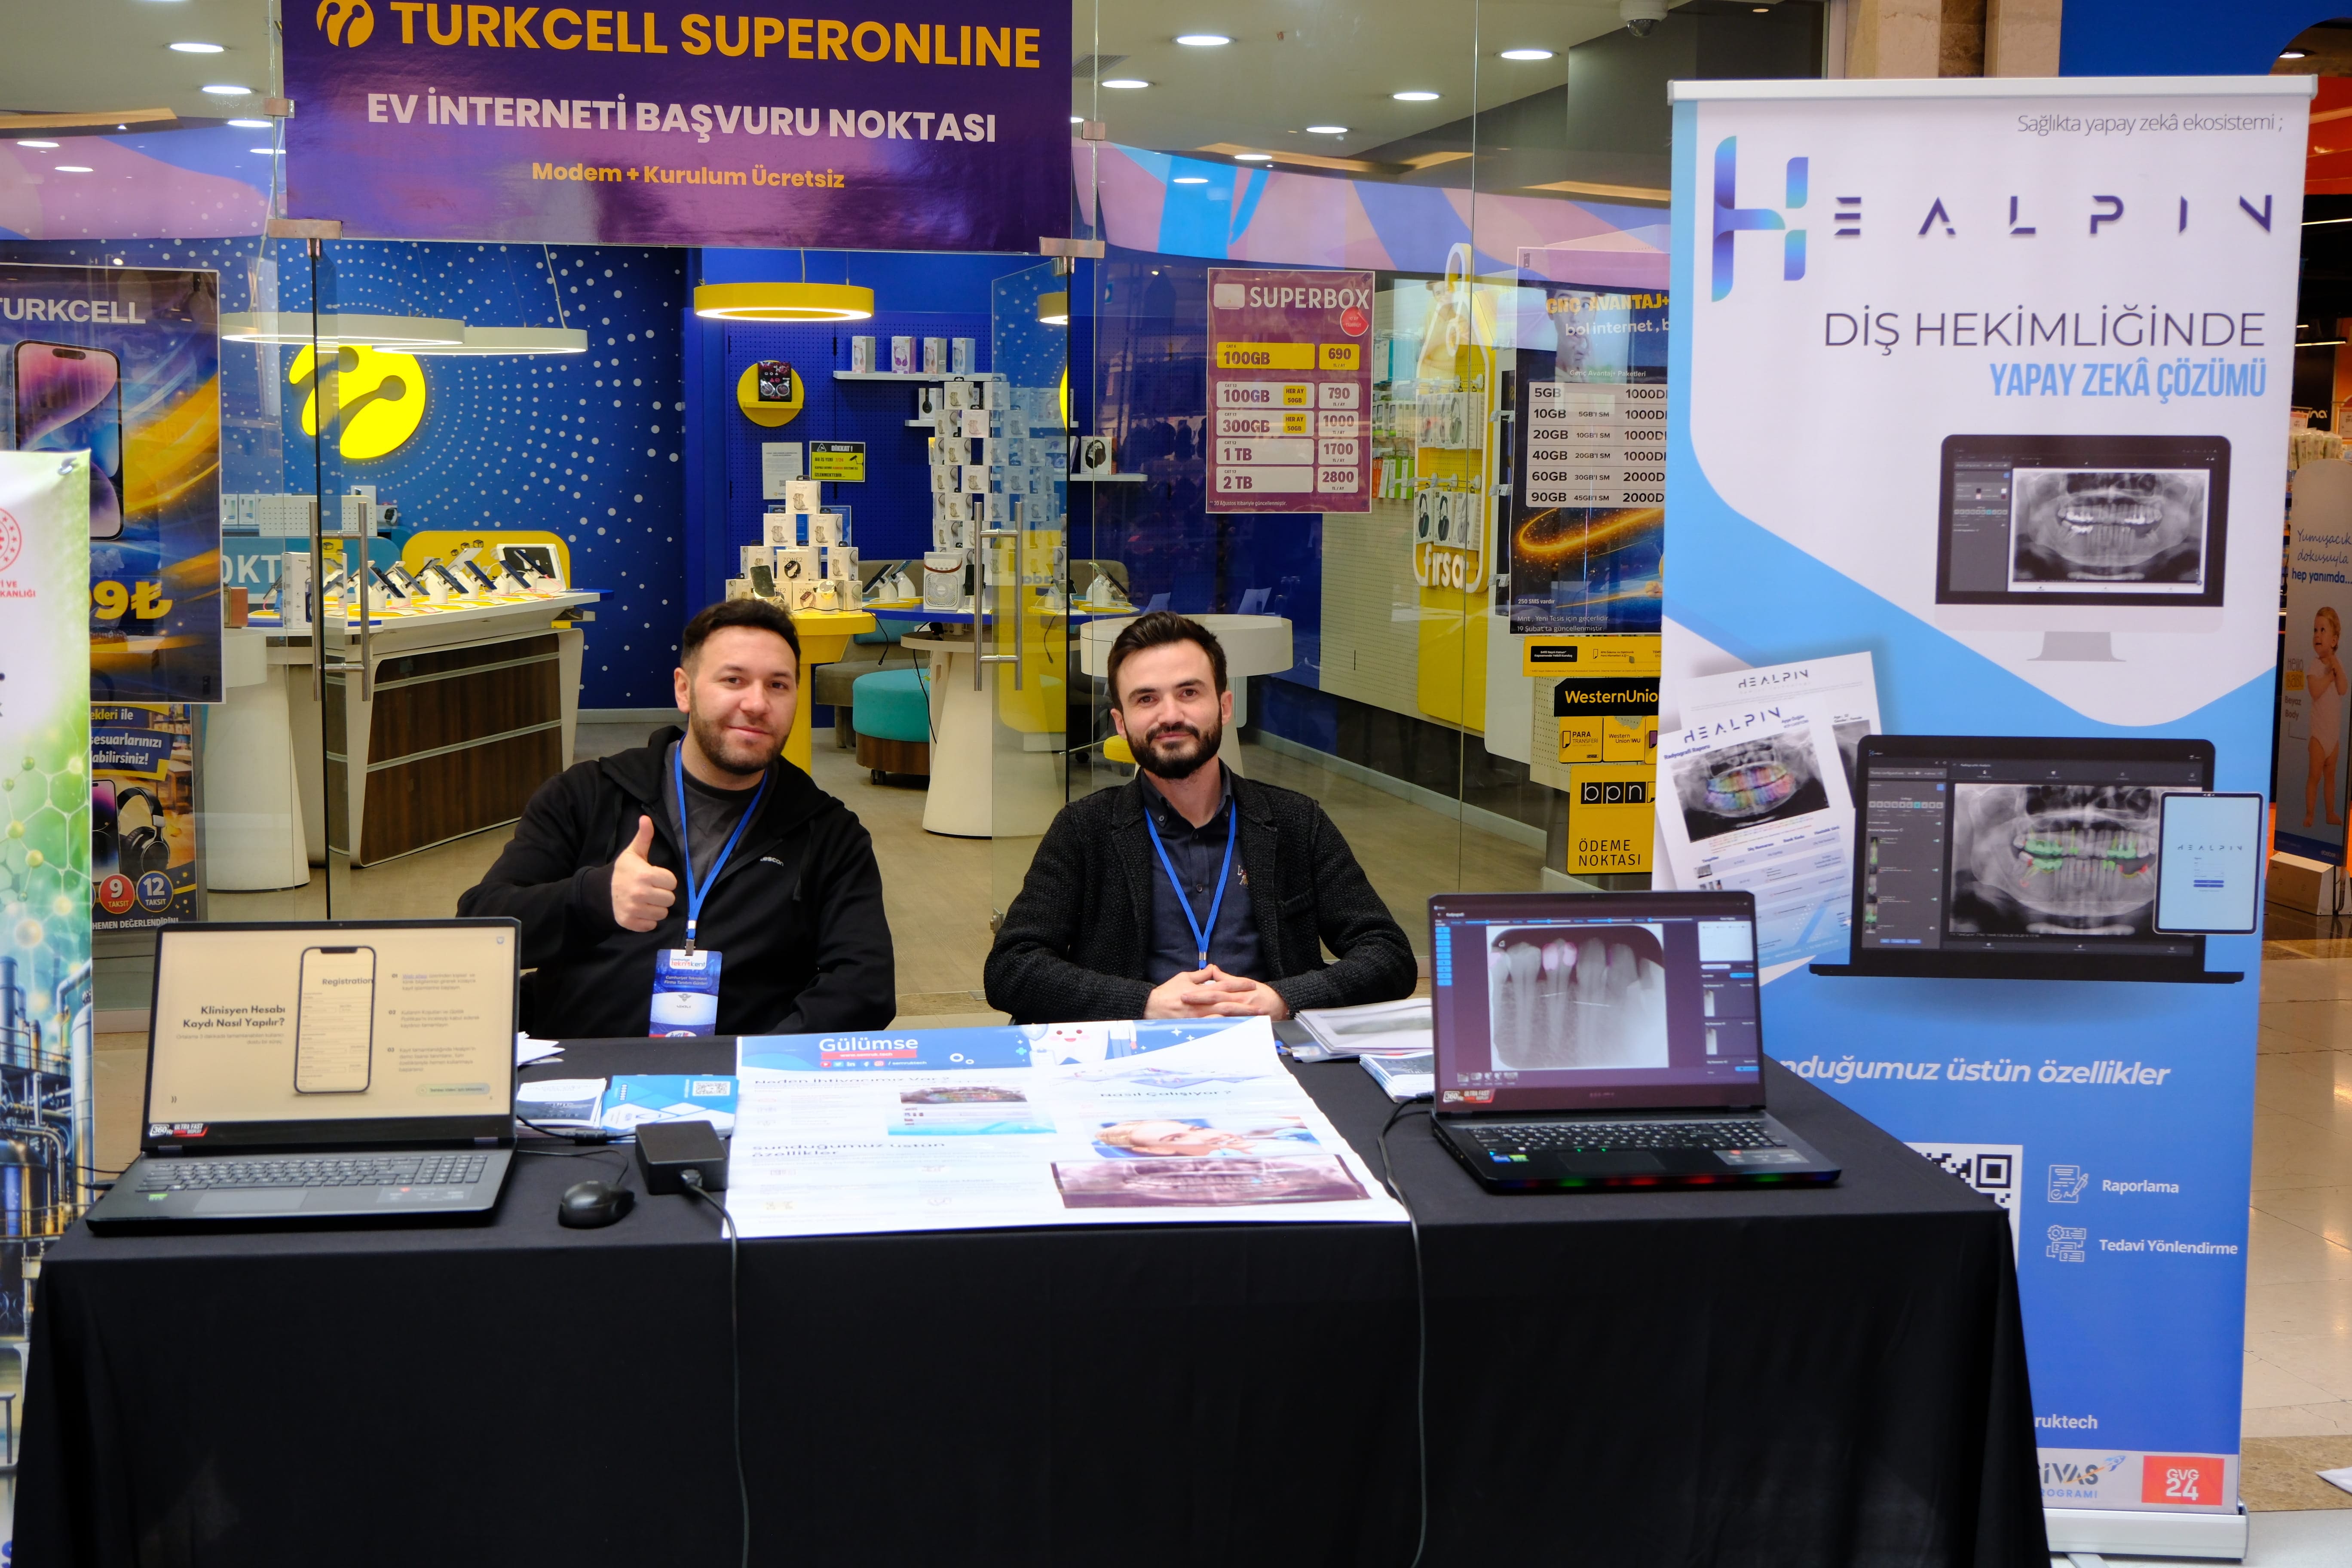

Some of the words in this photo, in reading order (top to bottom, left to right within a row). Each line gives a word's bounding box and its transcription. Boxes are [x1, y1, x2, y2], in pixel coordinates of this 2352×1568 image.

[389, 0, 669, 55] TURKCELL
[681, 12, 1041, 69] SUPERONLINE
[367, 92, 419, 124] EV
[427, 86, 627, 132] İNTERNETİ
[637, 102, 819, 143] BAŞVURU
[827, 107, 997, 143] NOKTASI
[2018, 113, 2082, 136] Sağlıkta
[2084, 117, 2136, 135] yapay
[2139, 113, 2178, 131] zekâ
[2183, 113, 2275, 131] ekosistemi
[532, 161, 622, 183] Modem
[643, 164, 747, 187] Kurulum
[751, 163, 845, 190] Ücretsiz
[1250, 287, 1369, 309] SUPERBOX
[0, 297, 146, 324] URKCELL
[1546, 297, 1581, 315] GNÇ
[1565, 323, 1589, 336] bol
[1593, 320, 1652, 334] internet
[1825, 305, 1899, 356] DİŞ
[1916, 303, 2265, 347] HEKİMLİĞİNDE
[1224, 352, 1270, 364] 100GB
[1328, 348, 1351, 360] 690
[1990, 363, 2078, 397] YAPAY
[2082, 356, 2150, 397] ZEKÂ
[2156, 358, 2266, 405] ÇÖZÜMÜ
[1224, 389, 1270, 403] 100GB
[1328, 388, 1350, 399] 790
[1534, 388, 1561, 398] 5GB
[1626, 389, 1668, 399] 1000D
[1323, 415, 1354, 427] 1000
[1534, 409, 1567, 419] 10GB
[1625, 410, 1668, 420] 1000D
[1223, 420, 1270, 433] 300GB
[1533, 430, 1568, 440] 20GB
[1624, 431, 1667, 441] 1000D
[1224, 448, 1230, 461] 1
[1234, 448, 1252, 461] TB
[1323, 443, 1353, 455] 1700
[1532, 450, 1568, 460] 40GB
[1624, 451, 1666, 461] 1000D
[1223, 476, 1231, 489] 2
[1236, 476, 1253, 489] TB
[1322, 471, 1354, 483] 2800
[1532, 471, 1568, 481] 60GB
[1531, 492, 1567, 502] 90GB
[2297, 529, 2352, 548] Yumuşacık
[2297, 548, 2349, 567] dokusuyla
[2292, 567, 2306, 582] hep
[1566, 615, 1577, 623] için
[1578, 615, 1610, 624] geçerlidir.
[1553, 625, 1605, 633] güncellenmiştir.
[1738, 669, 1809, 689] HEALPIN
[1565, 688, 1658, 704] WesternUnio
[121, 708, 134, 720] ile
[1684, 707, 1782, 744] HEALPIN
[92, 750, 149, 765] abilirsiniz!
[1581, 781, 1646, 804] bpn
[1578, 838, 1631, 852] ÖDEME
[1578, 853, 1641, 867] NOKTASI
[110, 879, 123, 898] 9
[143, 877, 165, 896] 12
[93, 921, 118, 929] HEMEN
[322, 977, 374, 987] Registration
[201, 1006, 248, 1016] Klinisyen
[251, 1004, 285, 1014] Hesabı
[183, 1019, 213, 1029] Kaydı
[217, 1018, 242, 1027] Nasıl
[245, 1017, 285, 1028] Yapılır?
[819, 1037, 918, 1052] Gülümse
[1947, 1057, 2032, 1083] üstün
[2038, 1059, 2171, 1087] özellikler
[2102, 1178, 2180, 1197] Raporlama
[2099, 1237, 2144, 1253] Tedavi
[2147, 1238, 2239, 1256] Yönlendirme
[2166, 1468, 2199, 1480] GVG
[2166, 1478, 2199, 1501] 24
